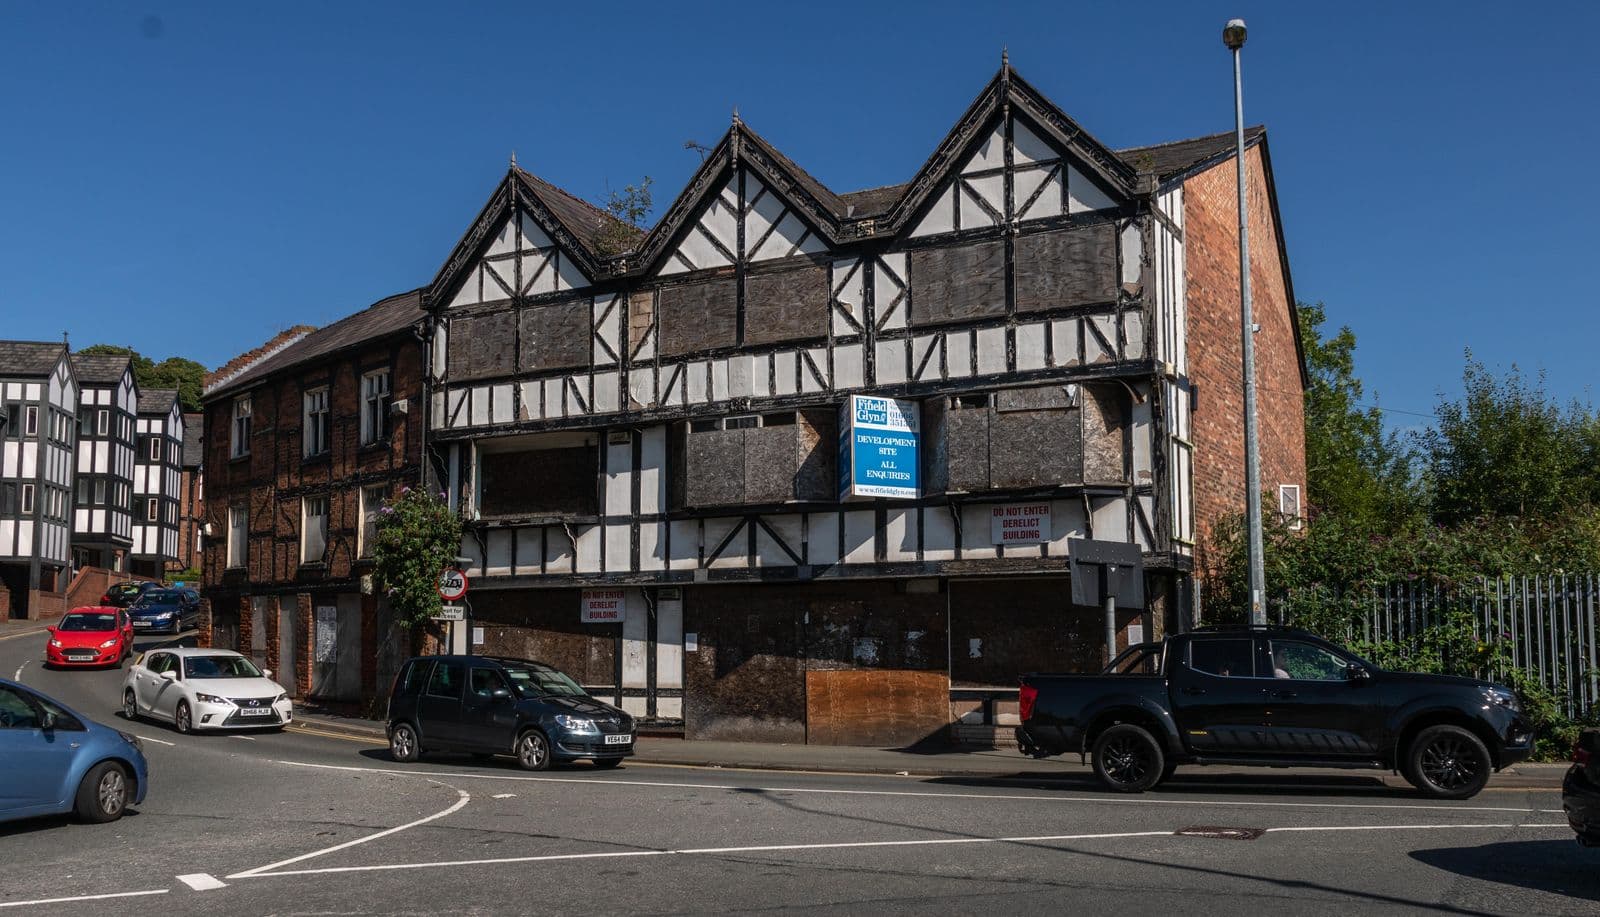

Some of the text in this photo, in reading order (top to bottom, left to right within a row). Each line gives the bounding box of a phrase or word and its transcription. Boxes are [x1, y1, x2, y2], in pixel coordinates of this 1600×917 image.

[857, 399, 887, 411] Fifield
[857, 410, 880, 423] Glyn
[857, 435, 917, 447] DEVELOPMENT
[879, 447, 897, 456] SITE
[866, 470, 911, 480] ENQUIRIES
[993, 506, 1049, 516] DO NOT ENTER
[1003, 518, 1040, 528] DERELICT
[1003, 530, 1040, 540] BUILDING
[592, 591, 604, 599] NOT
[605, 591, 624, 599] ENTER
[589, 601, 617, 609] DERELICT
[589, 611, 618, 619] BUILDING
